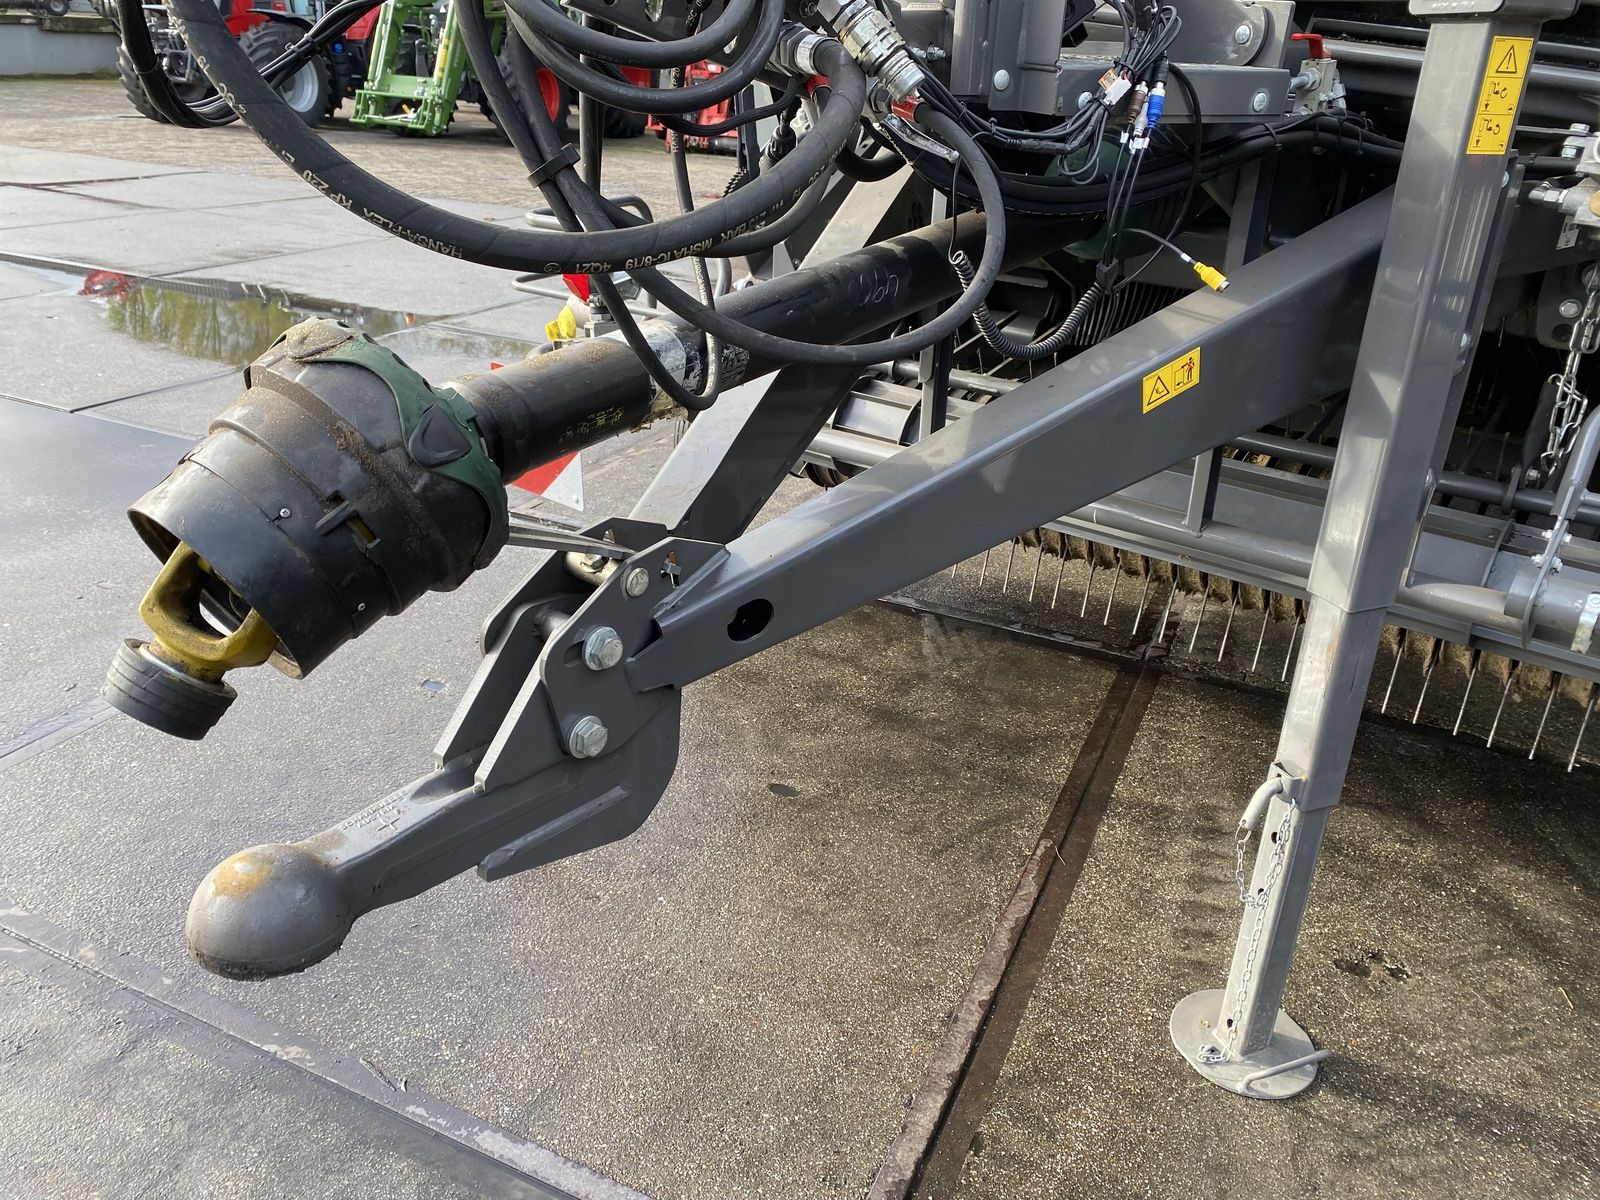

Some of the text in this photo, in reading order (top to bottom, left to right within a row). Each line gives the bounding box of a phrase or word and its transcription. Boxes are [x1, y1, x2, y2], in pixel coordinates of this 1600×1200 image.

[685, 10, 697, 27] 2SC
[302, 169, 330, 193] 220
[330, 192, 353, 210] KP
[363, 208, 464, 259] HANSA-FLEX
[721, 225, 747, 241] BAR
[674, 238, 713, 258] MSHA
[576, 262, 612, 273] 4Q21
[625, 251, 671, 270] IC-8/19
